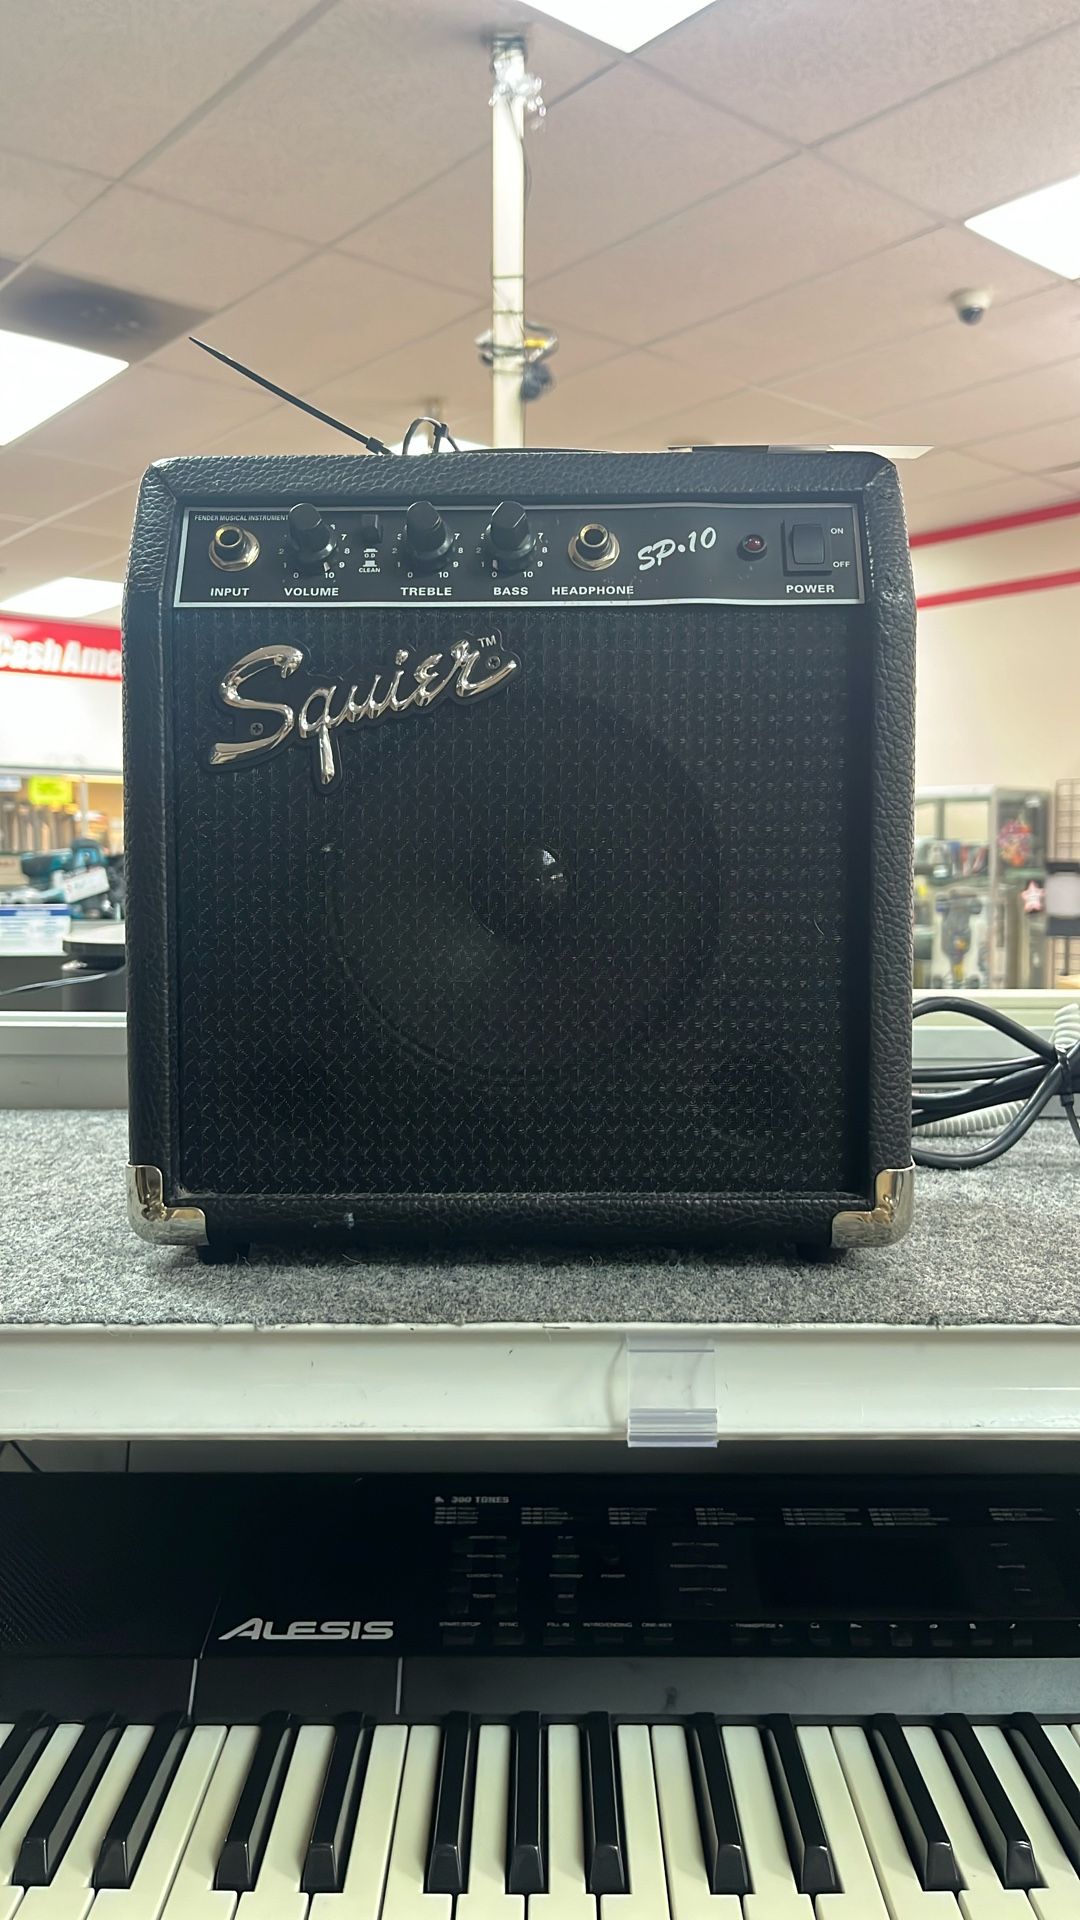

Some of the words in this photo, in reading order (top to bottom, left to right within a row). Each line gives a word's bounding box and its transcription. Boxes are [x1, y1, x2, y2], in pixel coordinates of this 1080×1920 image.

[194, 514, 219, 522] FENDER
[219, 514, 248, 522] MUSICAL
[830, 527, 845, 535] ON
[340, 533, 348, 541] 7
[537, 532, 545, 540] 7
[343, 547, 351, 555] 8
[457, 547, 464, 555] 8
[541, 546, 548, 554] 8
[338, 561, 346, 569] 9
[536, 560, 544, 568] 9
[324, 571, 335, 579] 10
[437, 571, 449, 579] 10
[210, 587, 250, 597] INPUT
[284, 587, 340, 597] VOLUME
[400, 586, 453, 597] TREBLE
[493, 586, 529, 596] BASS
[551, 585, 635, 596] HEADPHONE
[785, 583, 836, 594] POWER
[0, 633, 64, 672] Cash
[209, 640, 518, 785] Squier
[477, 635, 497, 648] TM
[217, 1616, 395, 1641] ALESIS
